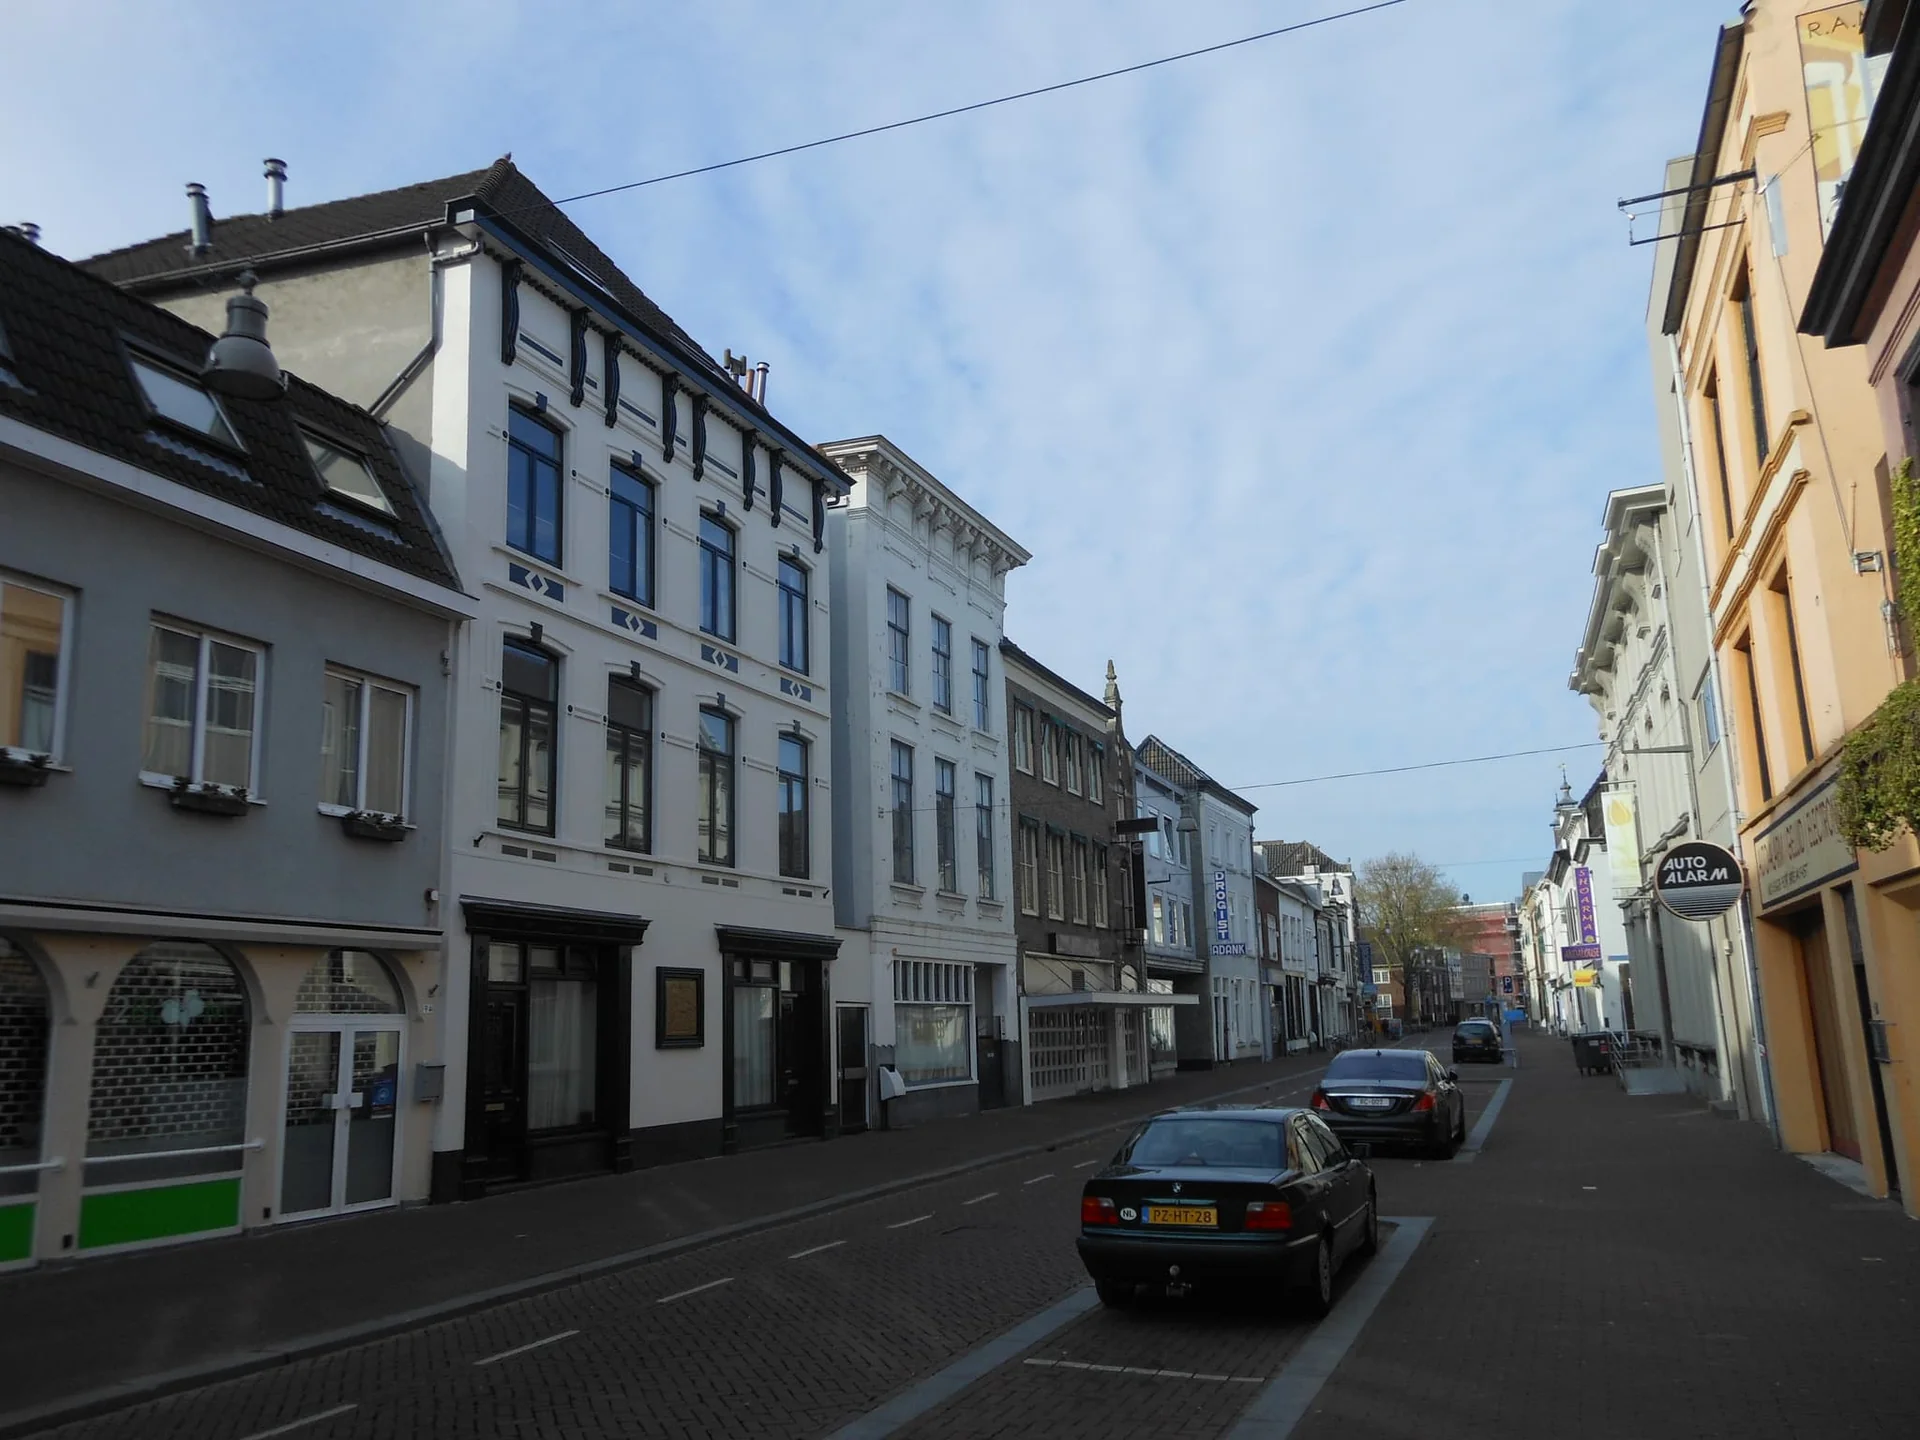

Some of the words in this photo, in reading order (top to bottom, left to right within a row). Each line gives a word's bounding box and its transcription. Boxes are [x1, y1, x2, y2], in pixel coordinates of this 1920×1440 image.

[1662, 856, 1706, 871] AUTO
[1664, 867, 1728, 885] ALARM
[1215, 872, 1229, 939] DROGIST
[1578, 868, 1594, 931] SHOARMA
[1212, 944, 1245, 956] ADANK
[1122, 1210, 1135, 1218] NL
[1153, 1209, 1212, 1223] PZ-HT-28
